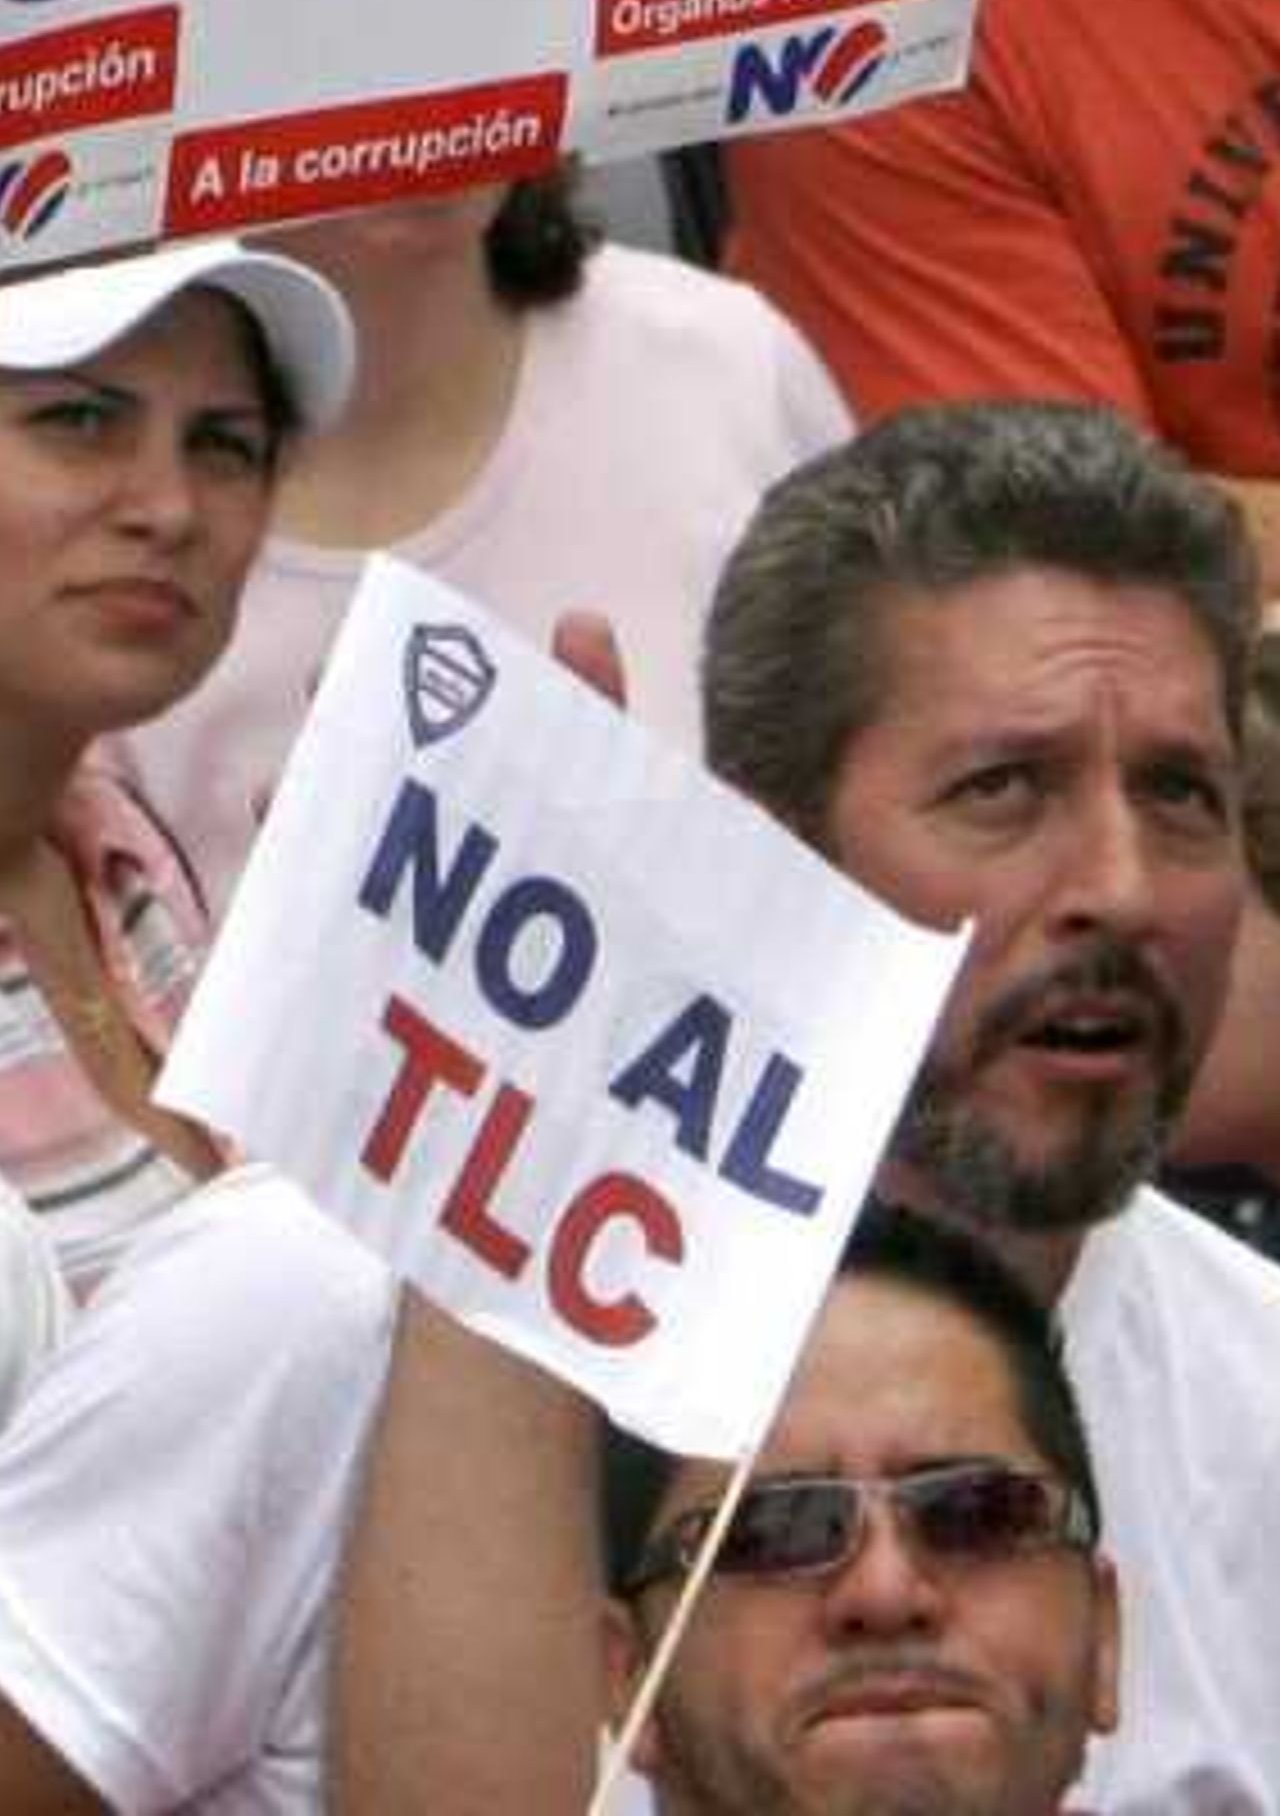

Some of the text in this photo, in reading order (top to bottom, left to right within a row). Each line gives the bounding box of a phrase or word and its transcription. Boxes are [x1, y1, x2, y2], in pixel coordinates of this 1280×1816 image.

[189, 155, 224, 206] A
[239, 148, 280, 193] la
[294, 108, 541, 181] corrupción
[357, 778, 828, 1219] NO AL
[357, 993, 684, 1348] TLC
